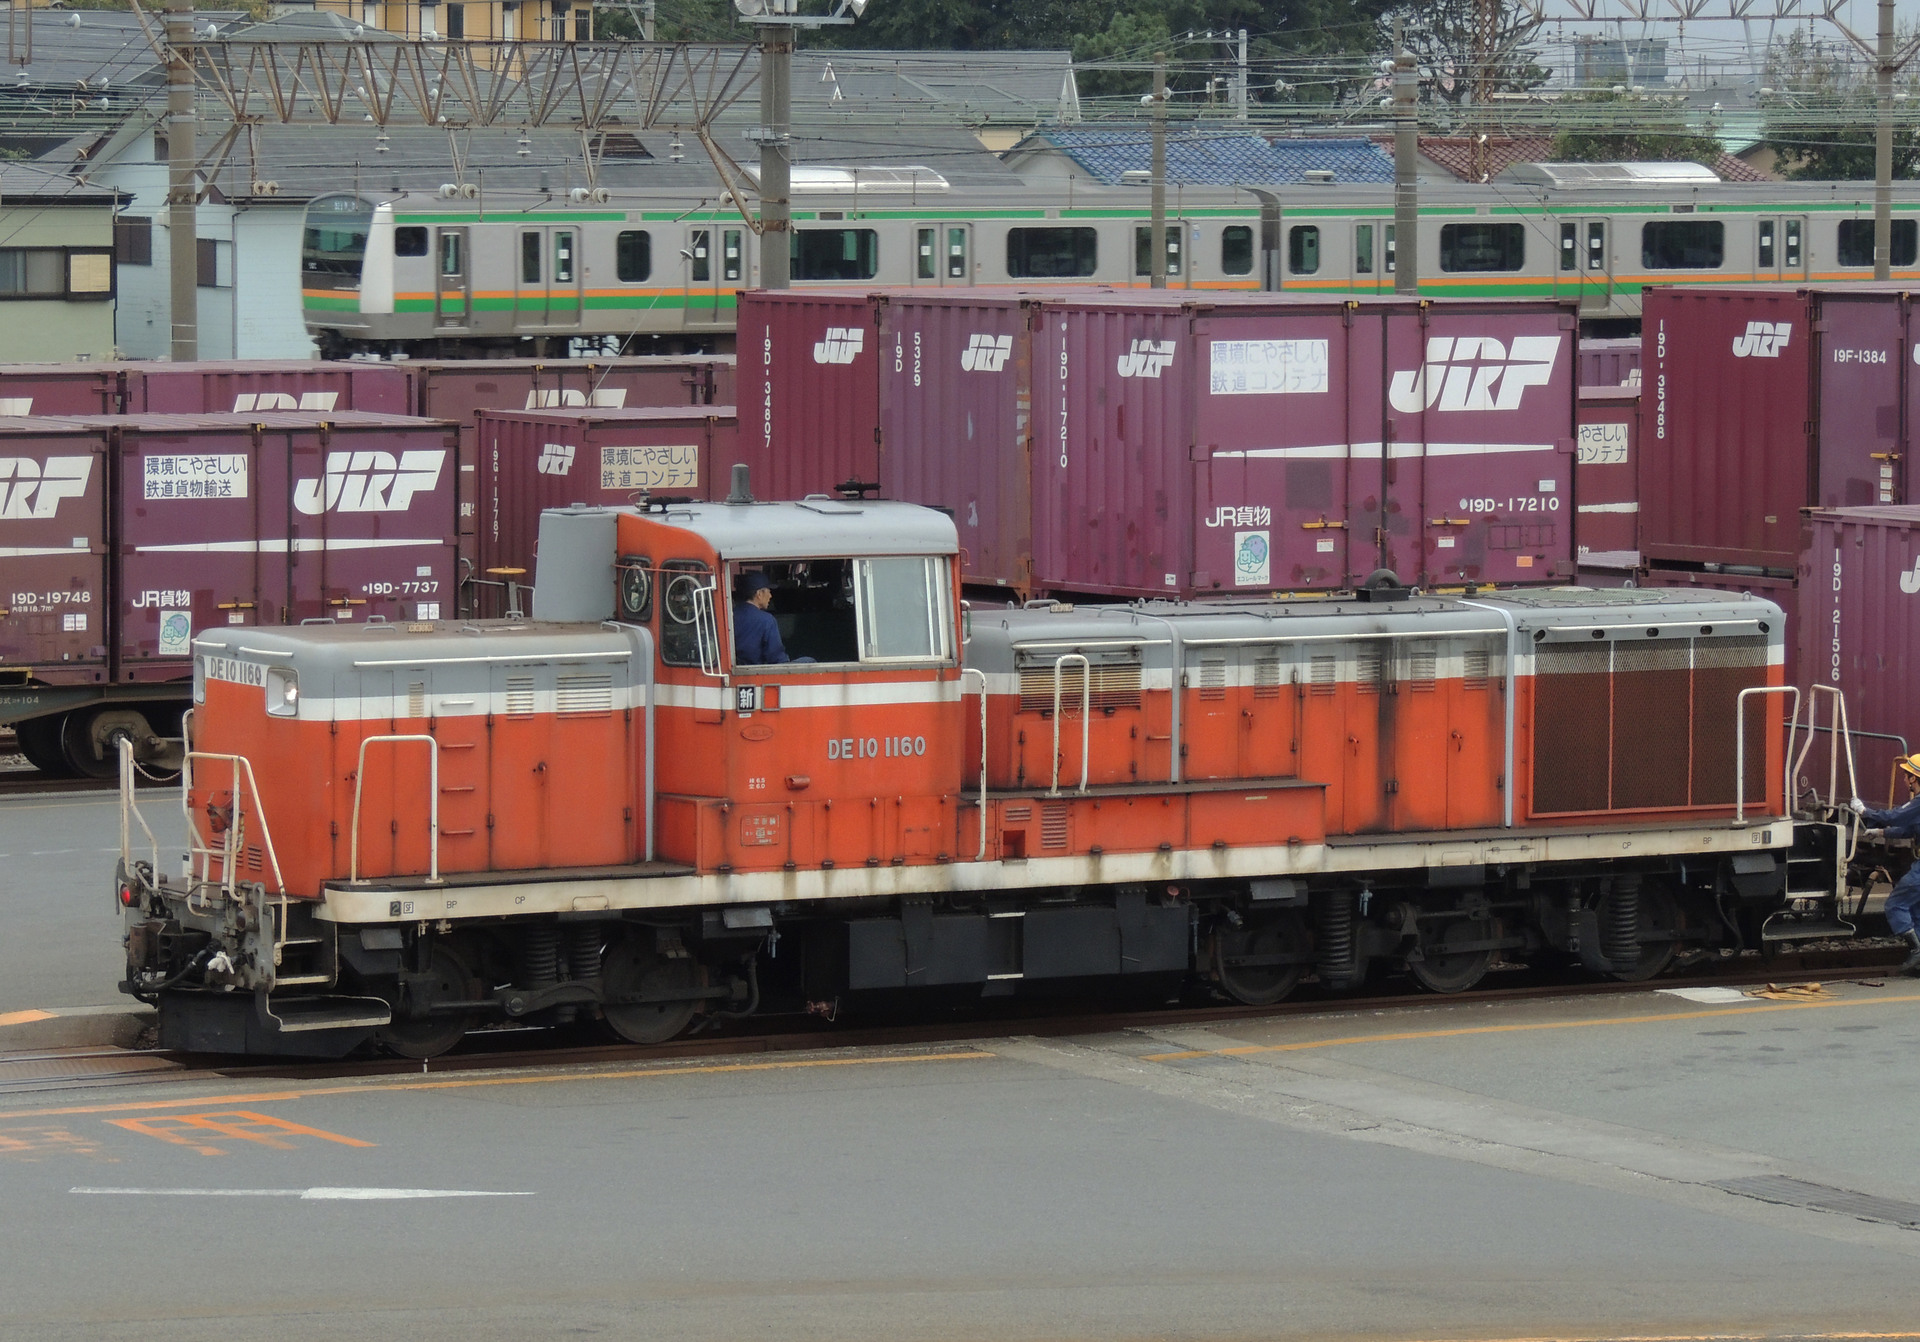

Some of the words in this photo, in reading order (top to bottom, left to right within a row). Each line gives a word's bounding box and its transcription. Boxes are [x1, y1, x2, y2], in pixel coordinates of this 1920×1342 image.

[814, 327, 865, 364] JRF
[1732, 321, 1792, 358] JRF
[913, 331, 921, 387] 5329
[961, 333, 1013, 372] JRF
[1117, 338, 1177, 379] JRF
[1211, 340, 1328, 365] 環境にやさしい
[1833, 349, 1887, 364] 19F-1384
[1211, 369, 1328, 394] 鉄道コンテナ
[1389, 336, 1562, 413] JRF
[1579, 424, 1628, 443] やさしい
[145, 456, 247, 477] 環境にやさしい
[537, 443, 576, 476] JRF
[602, 447, 698, 467] 環境にやさしい
[0, 456, 94, 519] RF
[145, 478, 232, 498] 鉄道貨物輸送
[294, 450, 447, 515] JRF
[602, 469, 698, 488] 鉄道コンテナ
[1205, 505, 1271, 527] JR貨物
[1468, 497, 1560, 513] 19D-17210
[12, 591, 91, 605] 19D-19748
[132, 589, 191, 608] JR貨物
[368, 581, 439, 595] 19D-7737
[239, 662, 262, 685] 1160
[739, 688, 754, 709] 新
[885, 735, 926, 758] 1160
[446, 900, 457, 908] BP
[515, 896, 526, 904] CP
